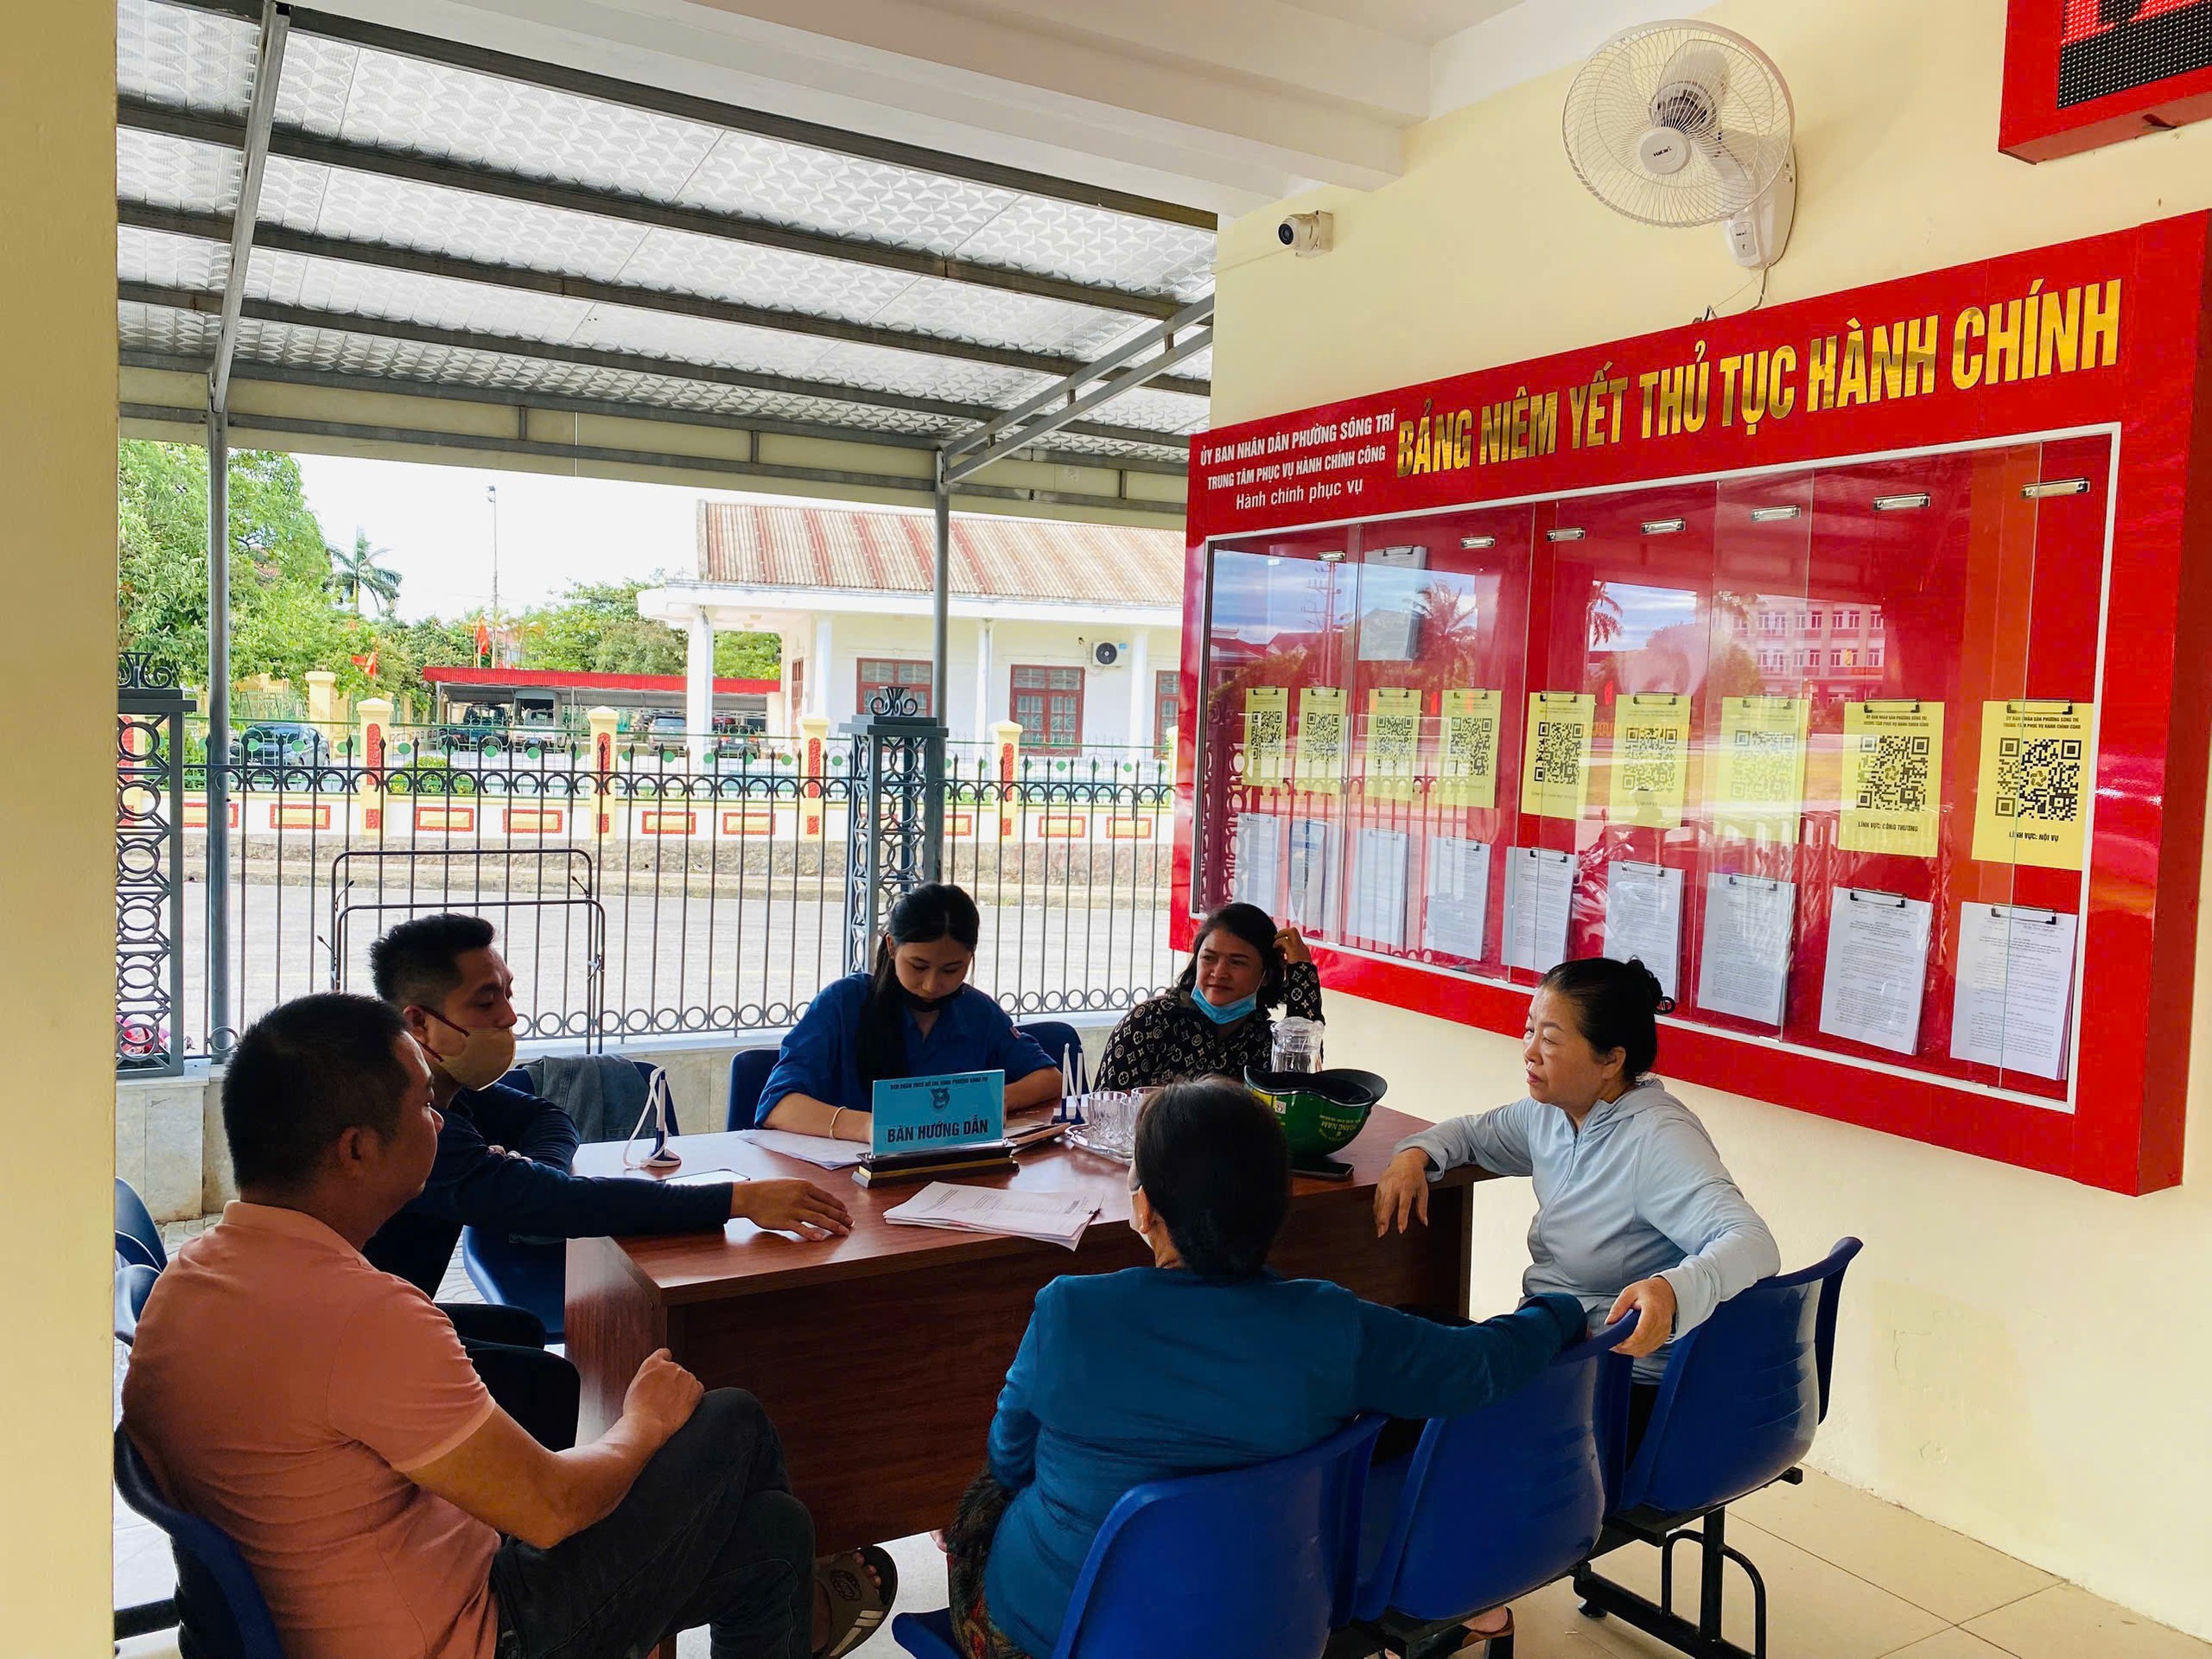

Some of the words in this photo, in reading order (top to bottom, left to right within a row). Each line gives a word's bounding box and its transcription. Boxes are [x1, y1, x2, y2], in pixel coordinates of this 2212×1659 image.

[1397, 397, 1472, 477] BẢNG
[1479, 386, 1558, 465] NIÊM
[1569, 360, 1629, 448] YẾT
[1639, 340, 1710, 439] THỦ
[1719, 346, 1797, 435] TỤC
[1807, 315, 1940, 413] HÀNH
[1951, 277, 2122, 391] CHÍNH
[1200, 444, 1212, 467] ỦY
[1215, 446, 1235, 463] BAN
[1237, 436, 1265, 459] NHÂN
[1268, 432, 1289, 453] DÂN
[1292, 423, 1337, 448] PHƯỜNG
[1339, 416, 1372, 441] SÔNG
[1376, 408, 1396, 432] TRÍ
[1208, 474, 1234, 491] TRUNG
[1236, 467, 1255, 486] TÂM
[1256, 465, 1280, 484] PHỤC
[1282, 461, 1294, 480] VỤ
[1296, 456, 1322, 475] HÀNH
[1325, 449, 1355, 470] CHÍNH
[1357, 445, 1386, 464] CÔNG
[1236, 491, 1266, 510] Hành
[1270, 486, 1304, 505] chính
[1309, 480, 1341, 503] phục
[1347, 478, 1363, 495] vụ
[918, 1120, 959, 1140] HƯỚNG
[963, 1115, 988, 1135] DẪN
